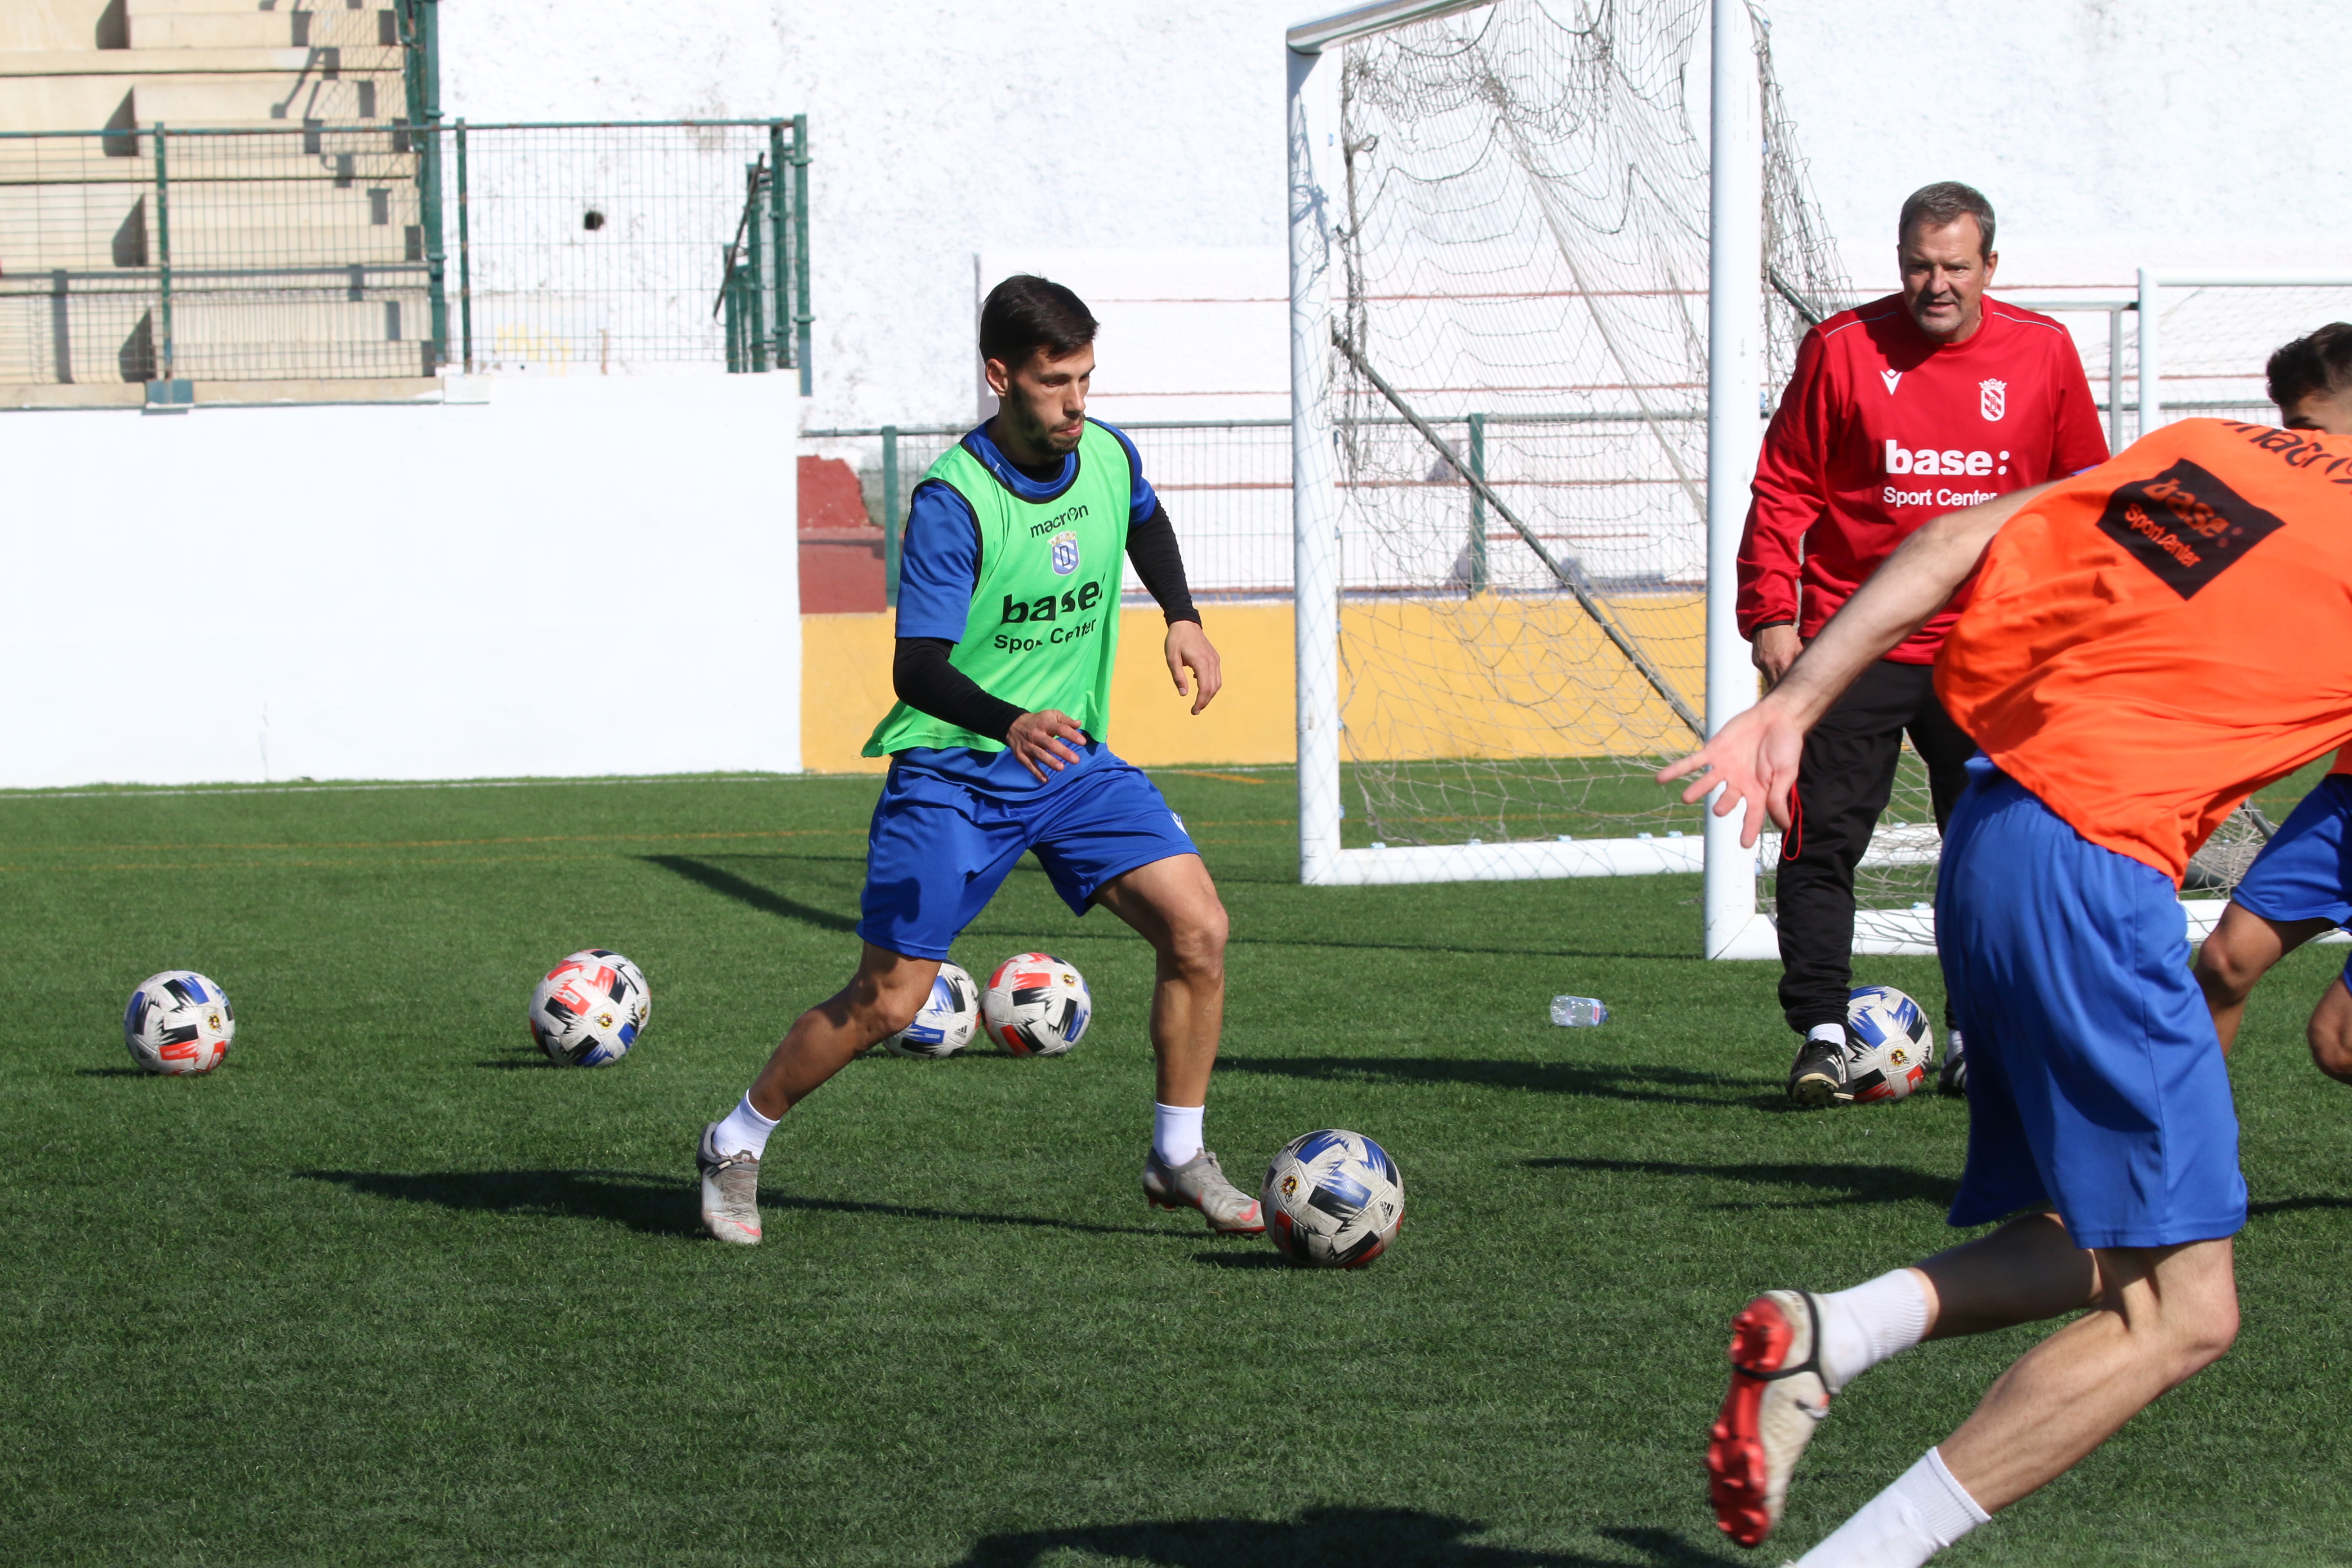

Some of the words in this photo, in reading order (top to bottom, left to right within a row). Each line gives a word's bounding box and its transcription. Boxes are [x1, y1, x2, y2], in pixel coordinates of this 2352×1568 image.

[1885, 439, 2010, 476] base:
[1883, 486, 1933, 508] Sport
[1936, 488, 1998, 507] Center
[1030, 505, 1089, 538] macron
